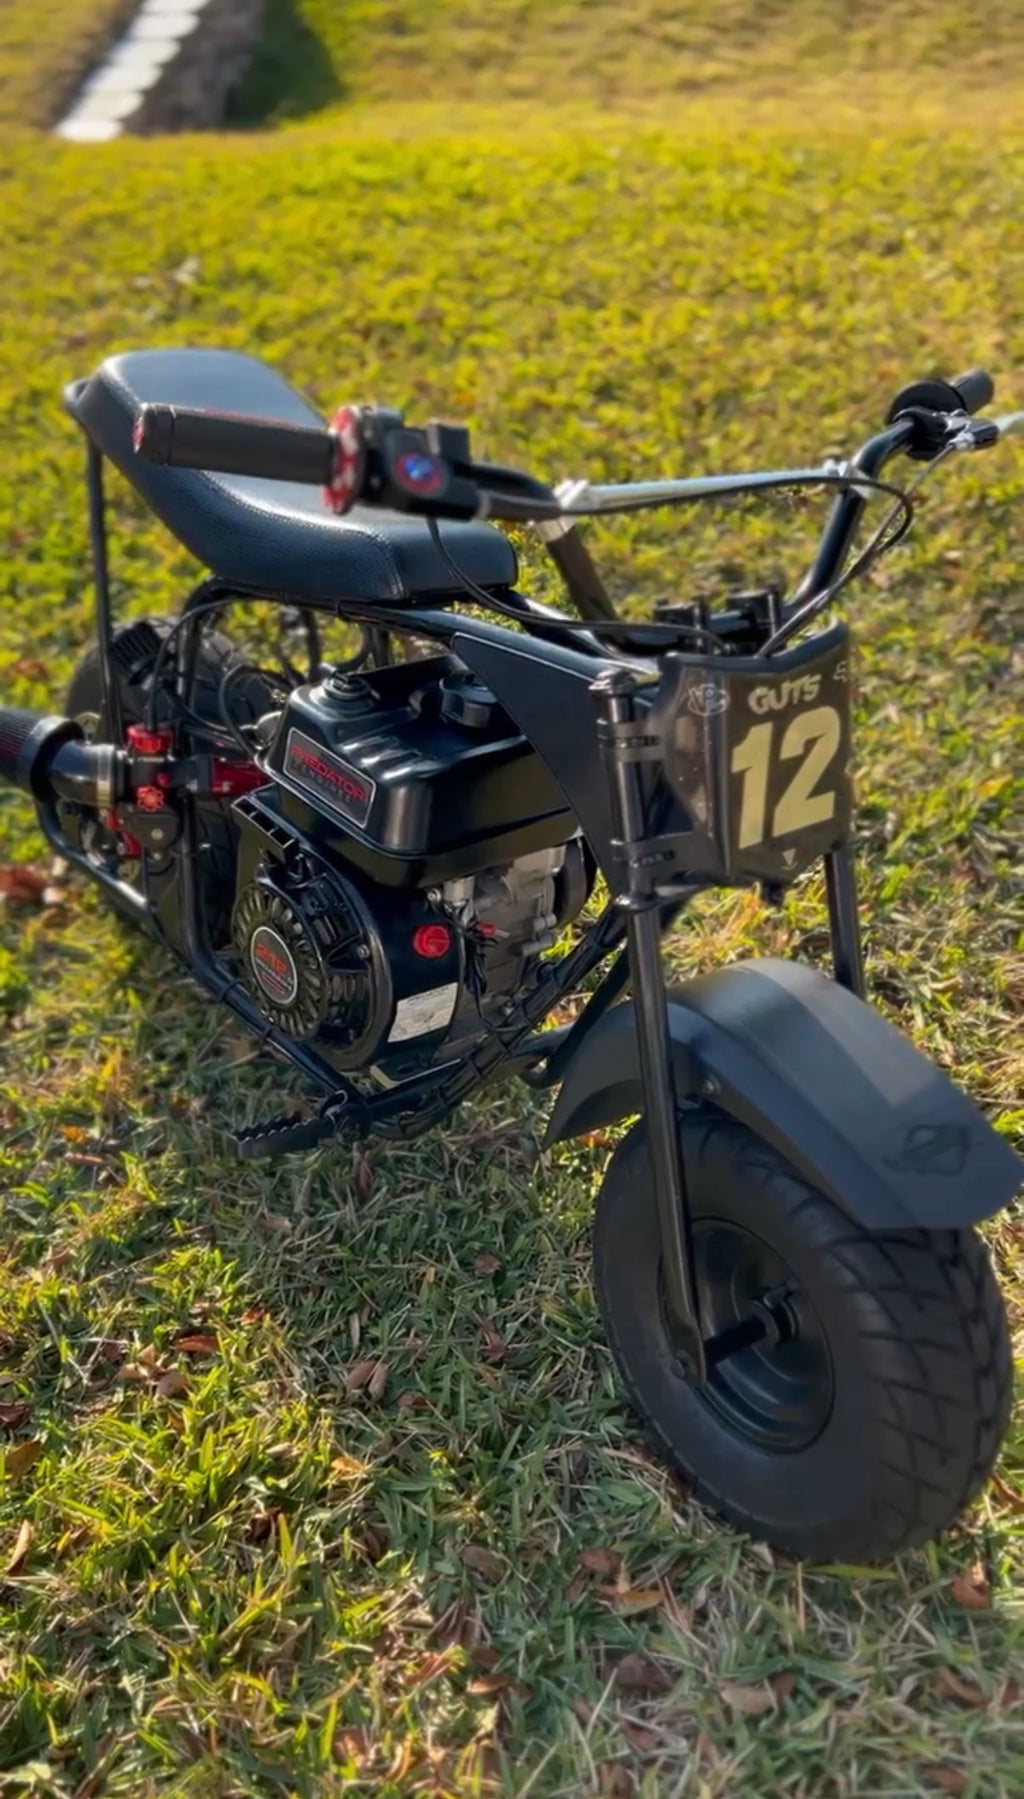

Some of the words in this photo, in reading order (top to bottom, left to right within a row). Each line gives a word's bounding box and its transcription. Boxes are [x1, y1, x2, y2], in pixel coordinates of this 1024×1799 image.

[748, 674, 822, 715] GUTS
[290, 744, 365, 802] PREDATOR
[731, 705, 841, 849] 12
